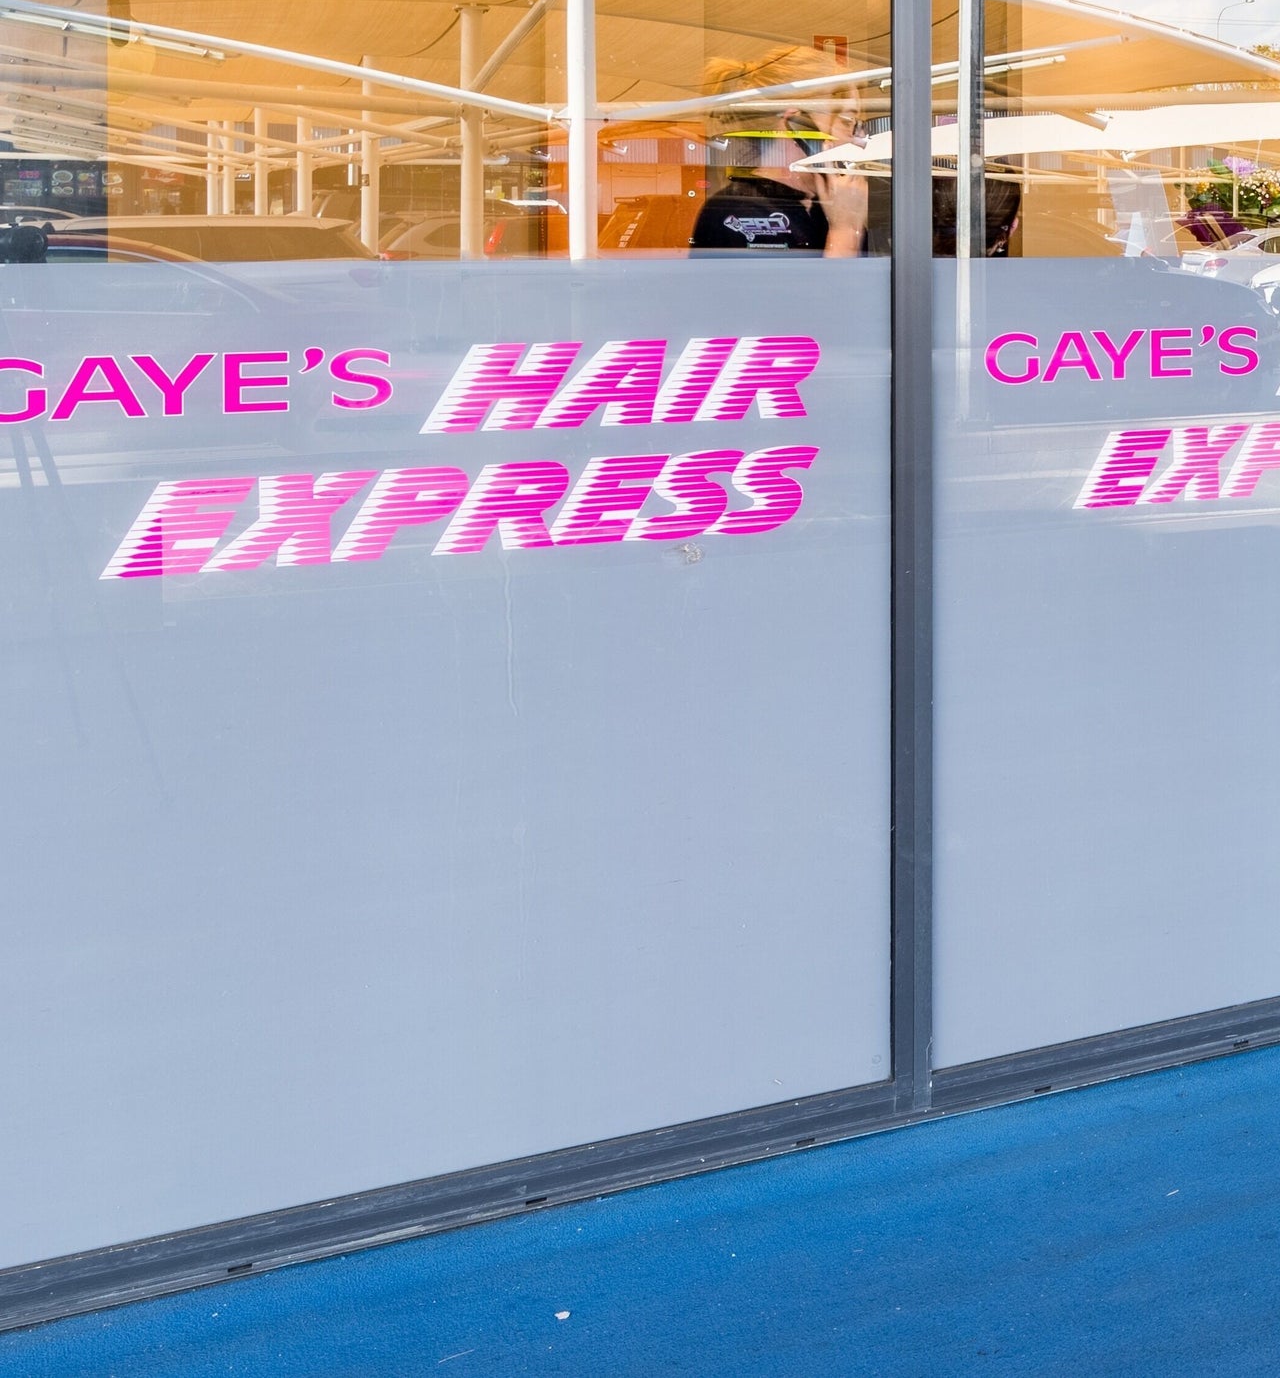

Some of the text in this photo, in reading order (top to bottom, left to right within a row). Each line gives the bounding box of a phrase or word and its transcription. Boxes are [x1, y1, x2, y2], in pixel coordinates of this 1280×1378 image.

[419, 334, 822, 435] HAIR
[983, 324, 1260, 386] GAYE'S
[98, 444, 822, 581] EXPRESS
